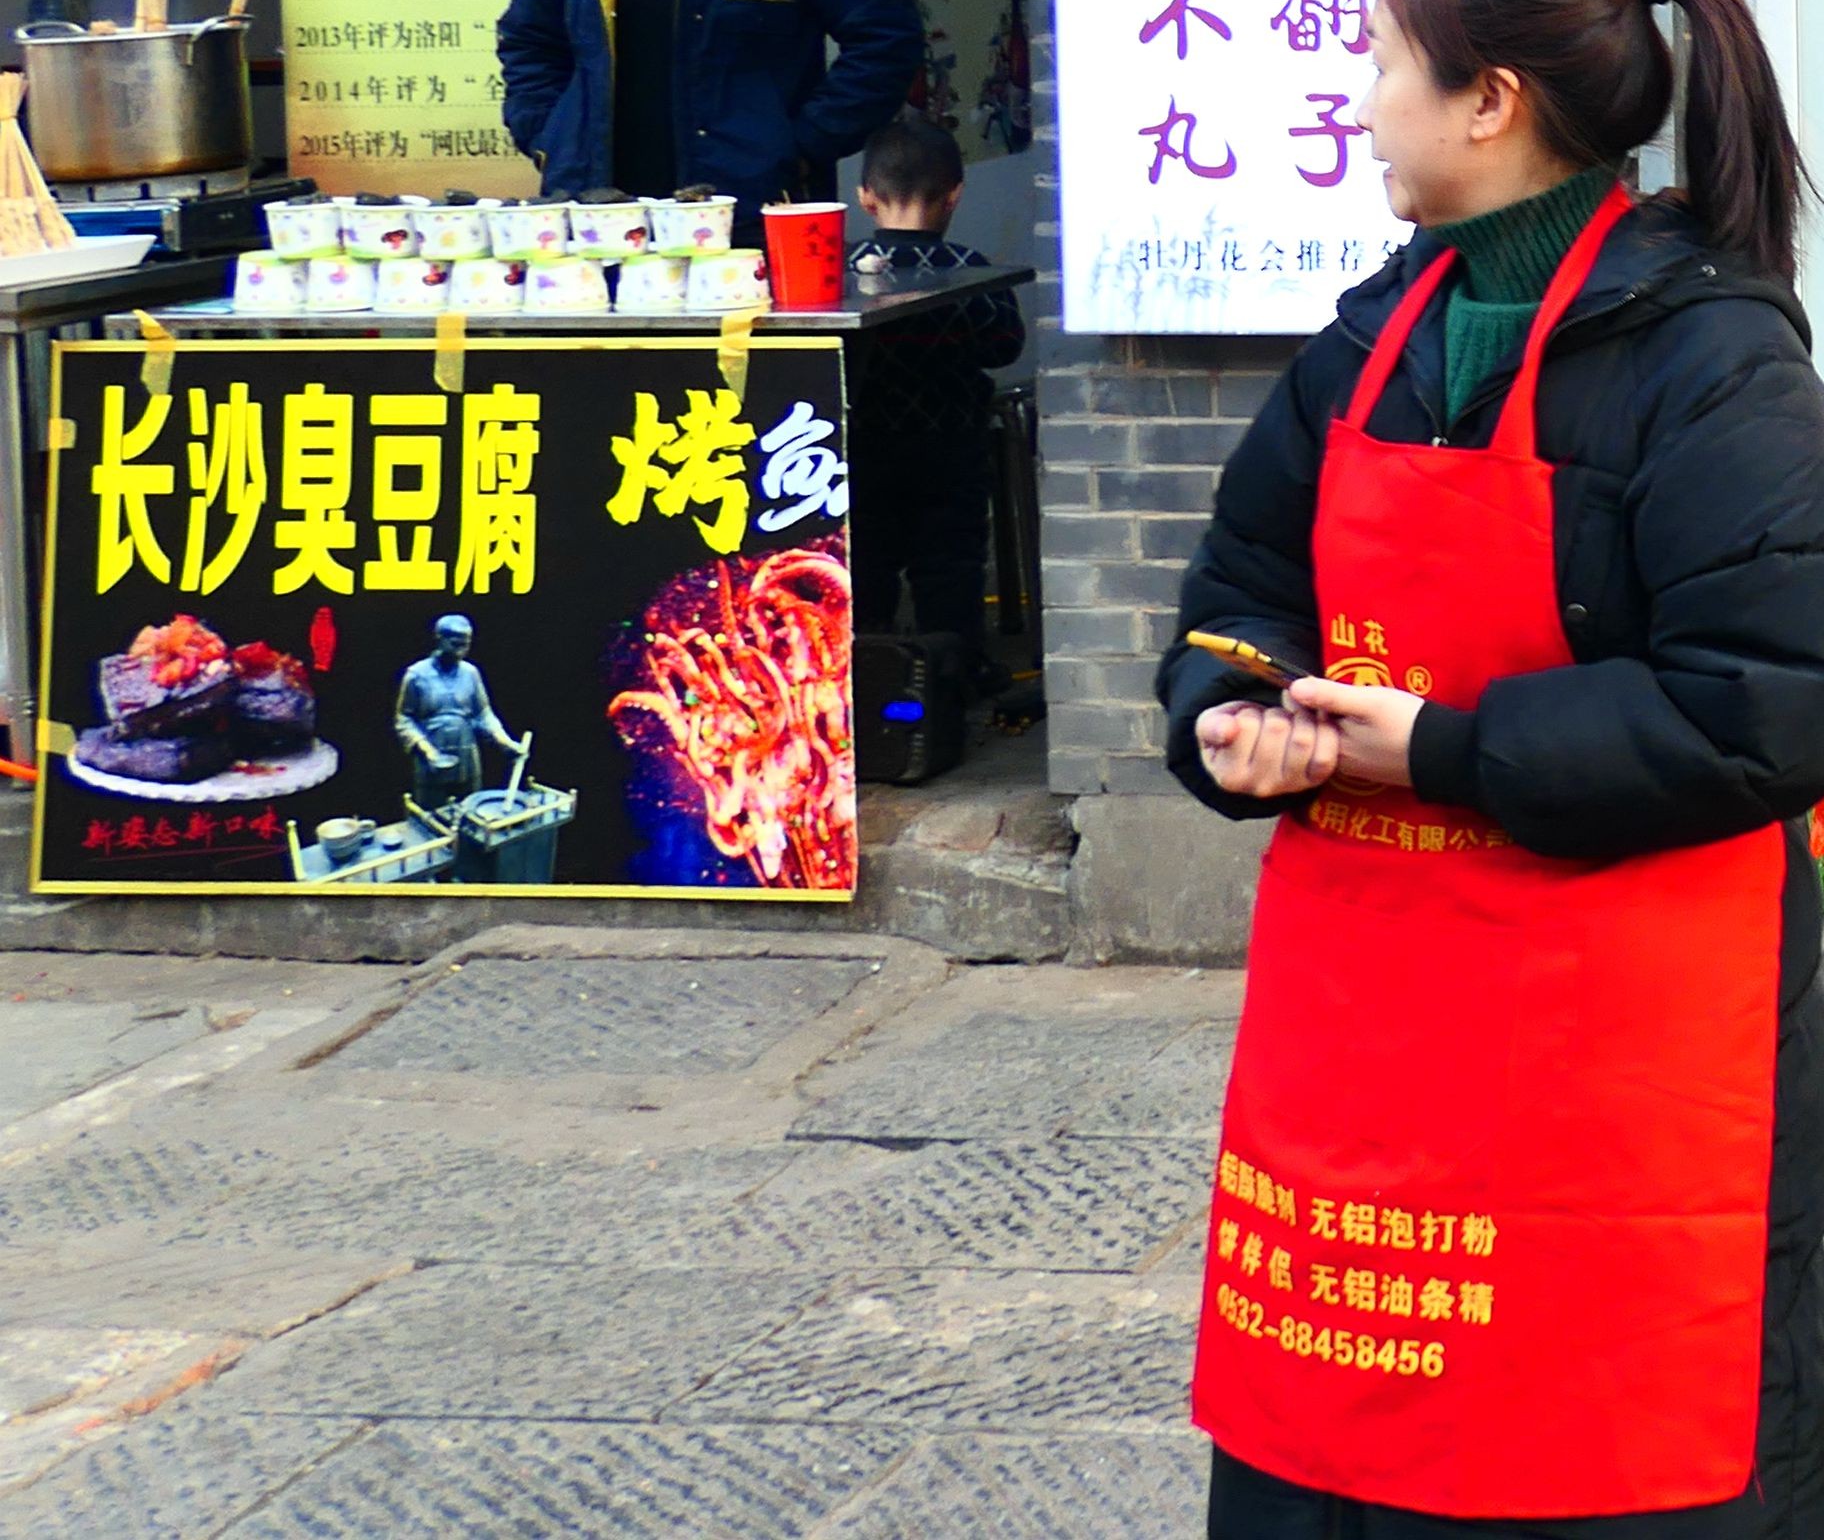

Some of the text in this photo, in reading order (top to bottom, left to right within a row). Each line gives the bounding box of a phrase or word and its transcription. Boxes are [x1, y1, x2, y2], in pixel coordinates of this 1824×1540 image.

[1138, 92, 1364, 188] 丸子
[92, 381, 542, 596] 长沙臭豆腐
[1309, 1196, 1498, 1256] 无铝泡打粉
[1216, 1282, 1447, 1378] 0532-88458456
[1309, 1262, 1495, 1326] 无铝油条精
